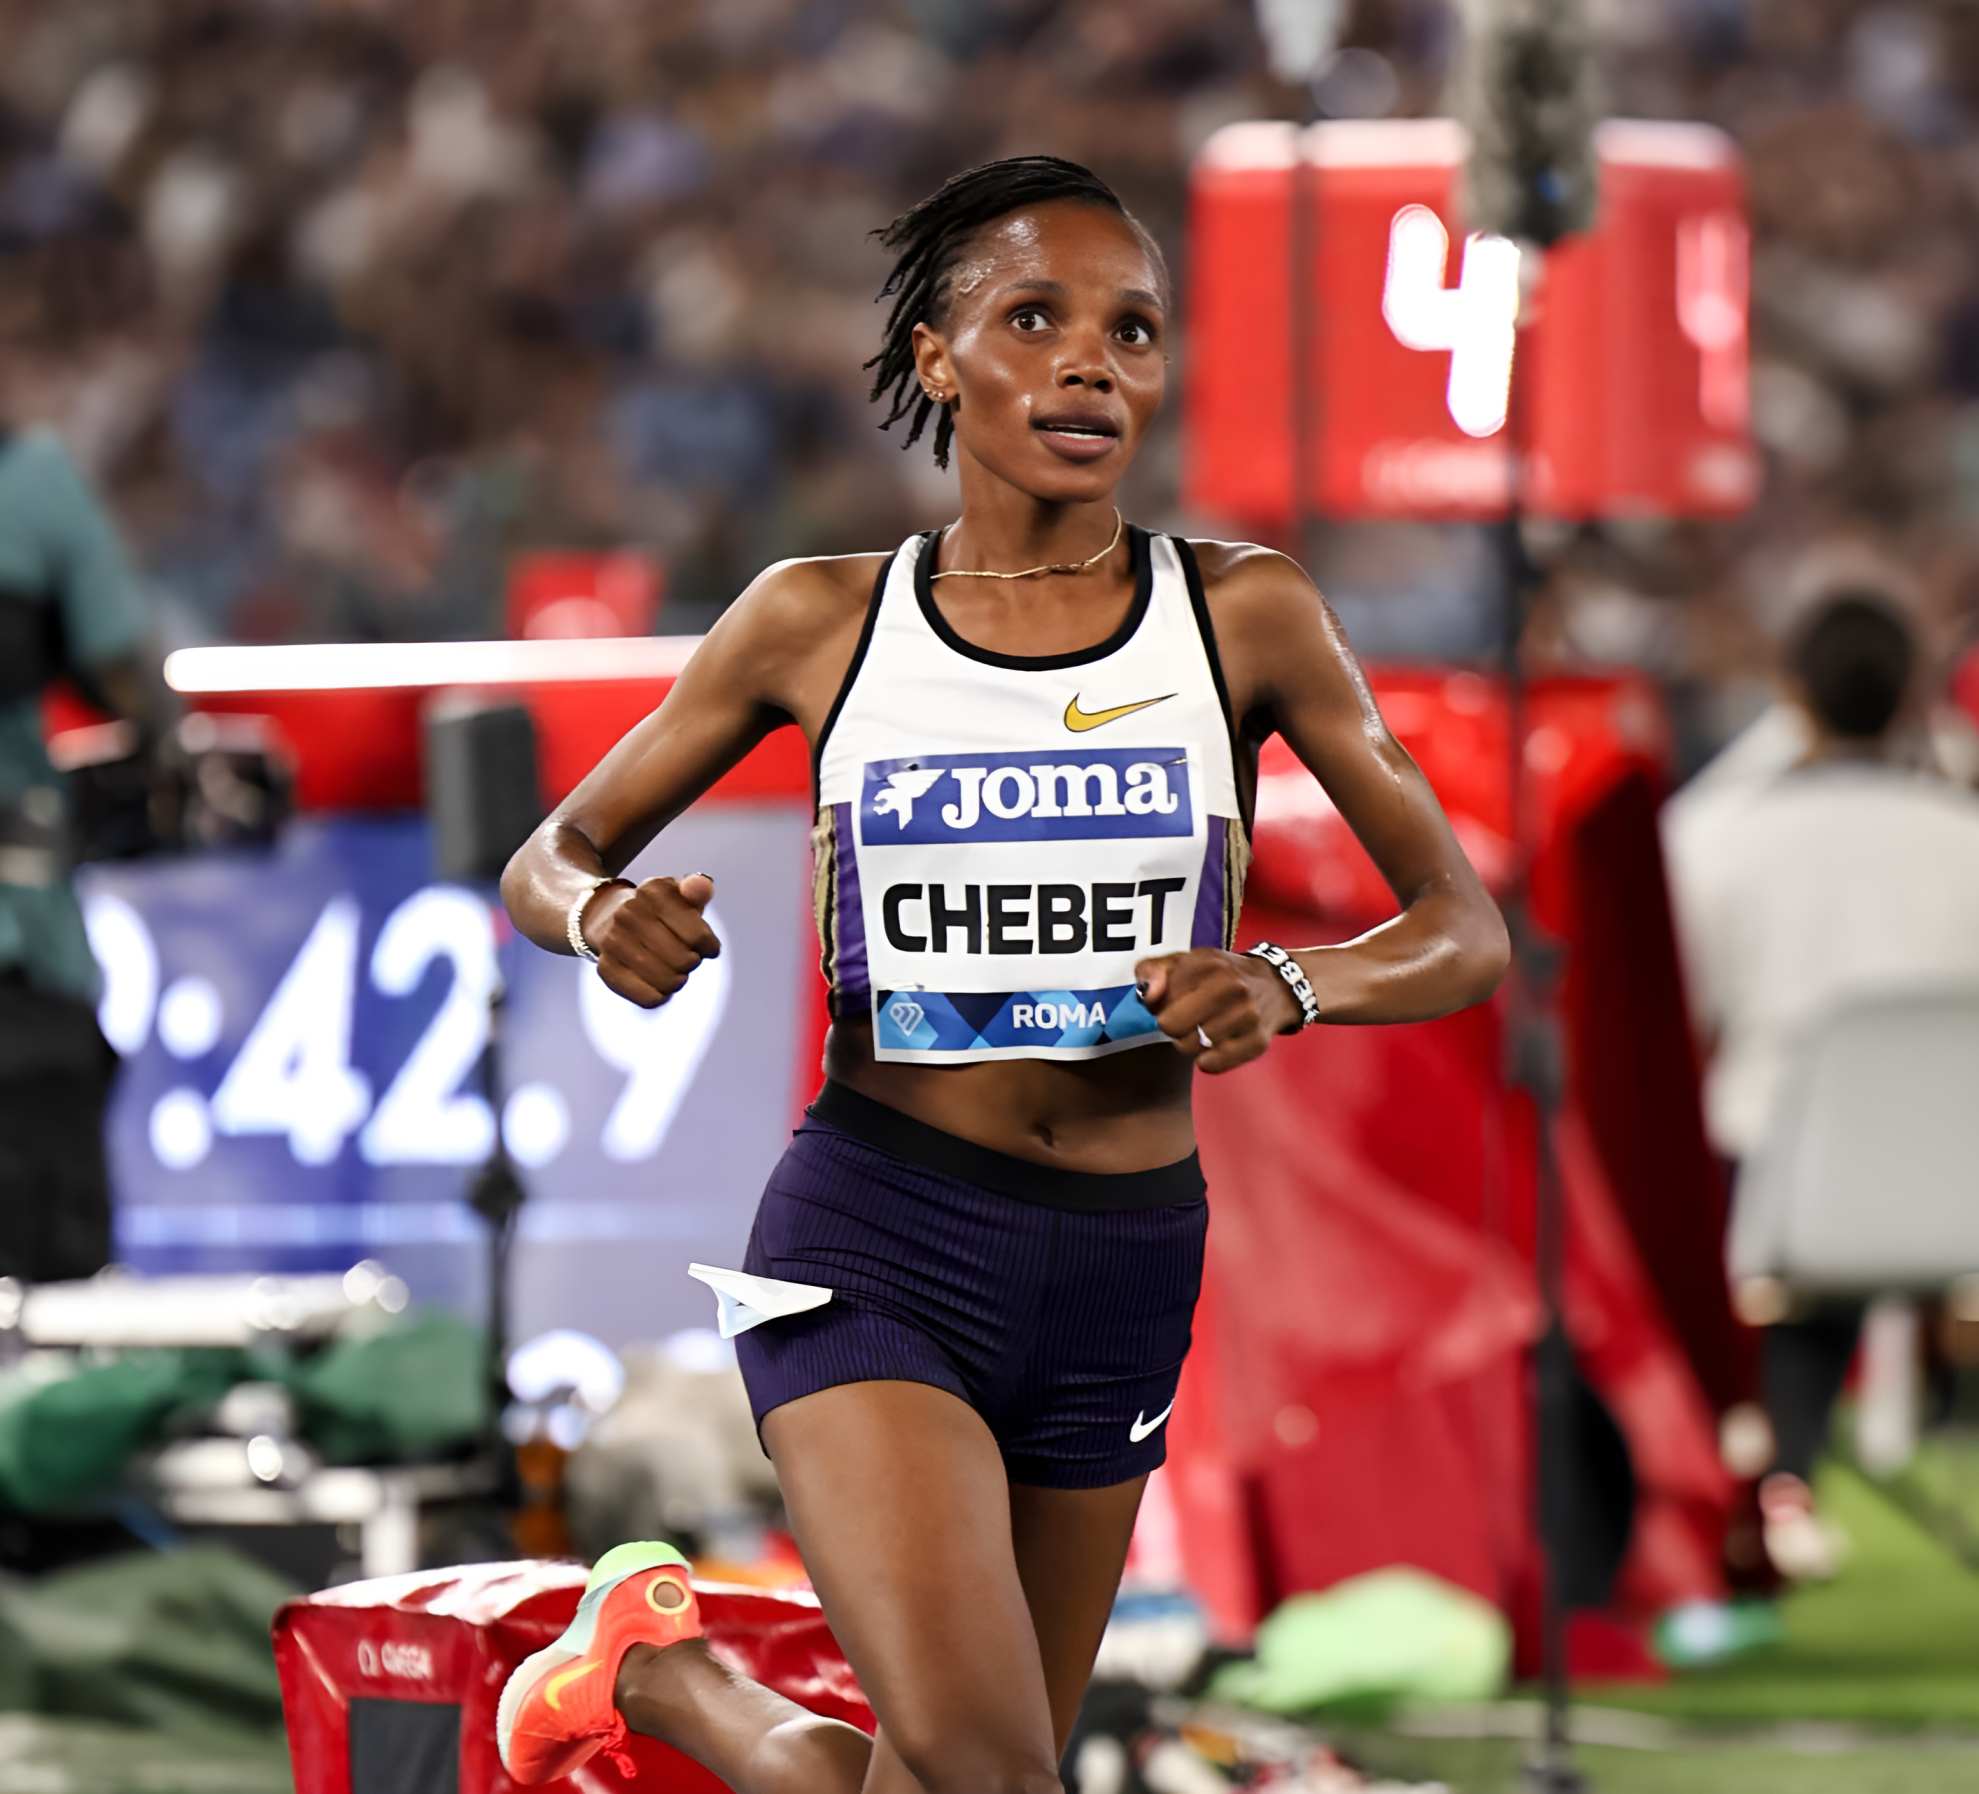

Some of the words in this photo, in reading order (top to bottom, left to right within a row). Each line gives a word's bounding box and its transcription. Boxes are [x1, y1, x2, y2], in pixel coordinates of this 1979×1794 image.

[1382, 203, 1520, 437] 4
[882, 876, 1187, 955] CHEBET
[1012, 1002, 1106, 1030] ROMA
